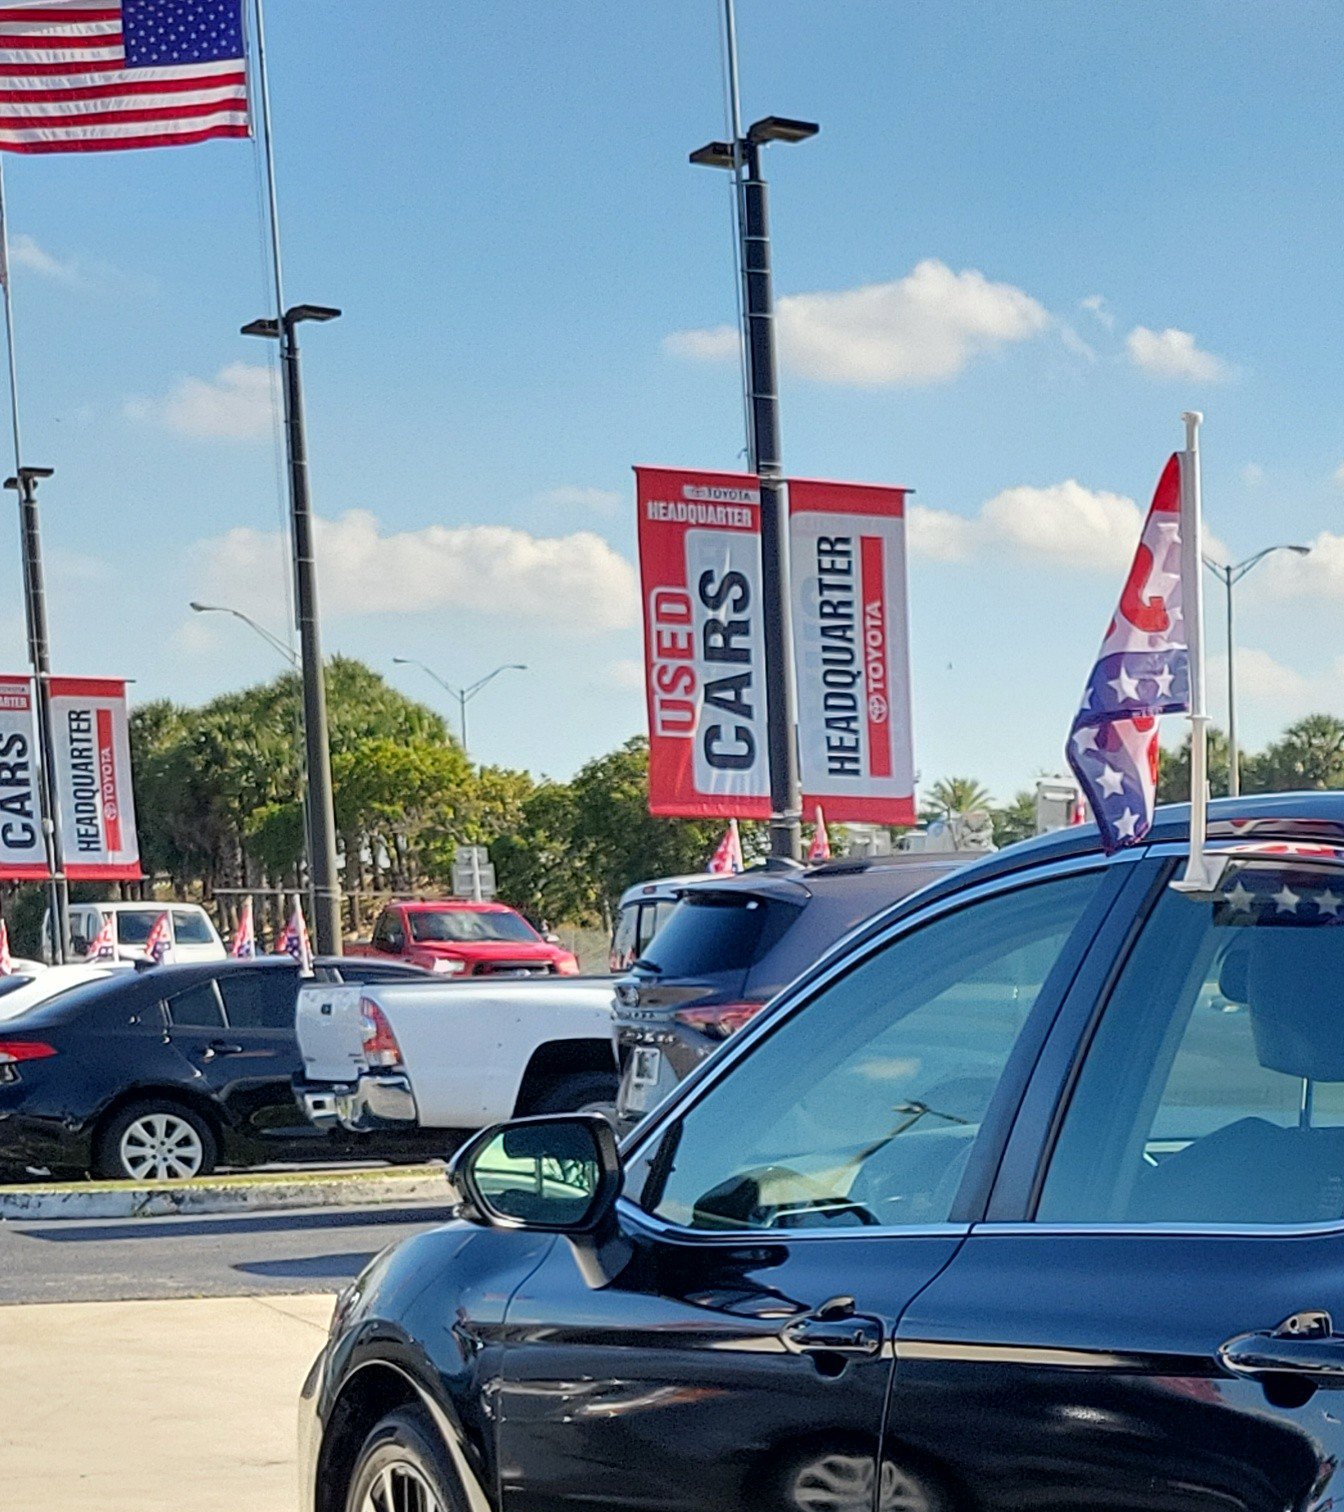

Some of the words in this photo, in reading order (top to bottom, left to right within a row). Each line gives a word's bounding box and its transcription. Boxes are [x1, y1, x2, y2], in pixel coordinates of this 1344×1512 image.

[647, 501, 753, 528] HEADQUARTER
[708, 487, 753, 501] TOYOTA
[655, 589, 697, 737] USED
[699, 569, 756, 771] CARS
[816, 535, 862, 778] HEADQUARTER
[864, 601, 885, 694] TOYOTA
[0, 732, 37, 850] CARS
[68, 708, 102, 852] HEADQUARTER
[101, 747, 116, 803] TOYOTA
